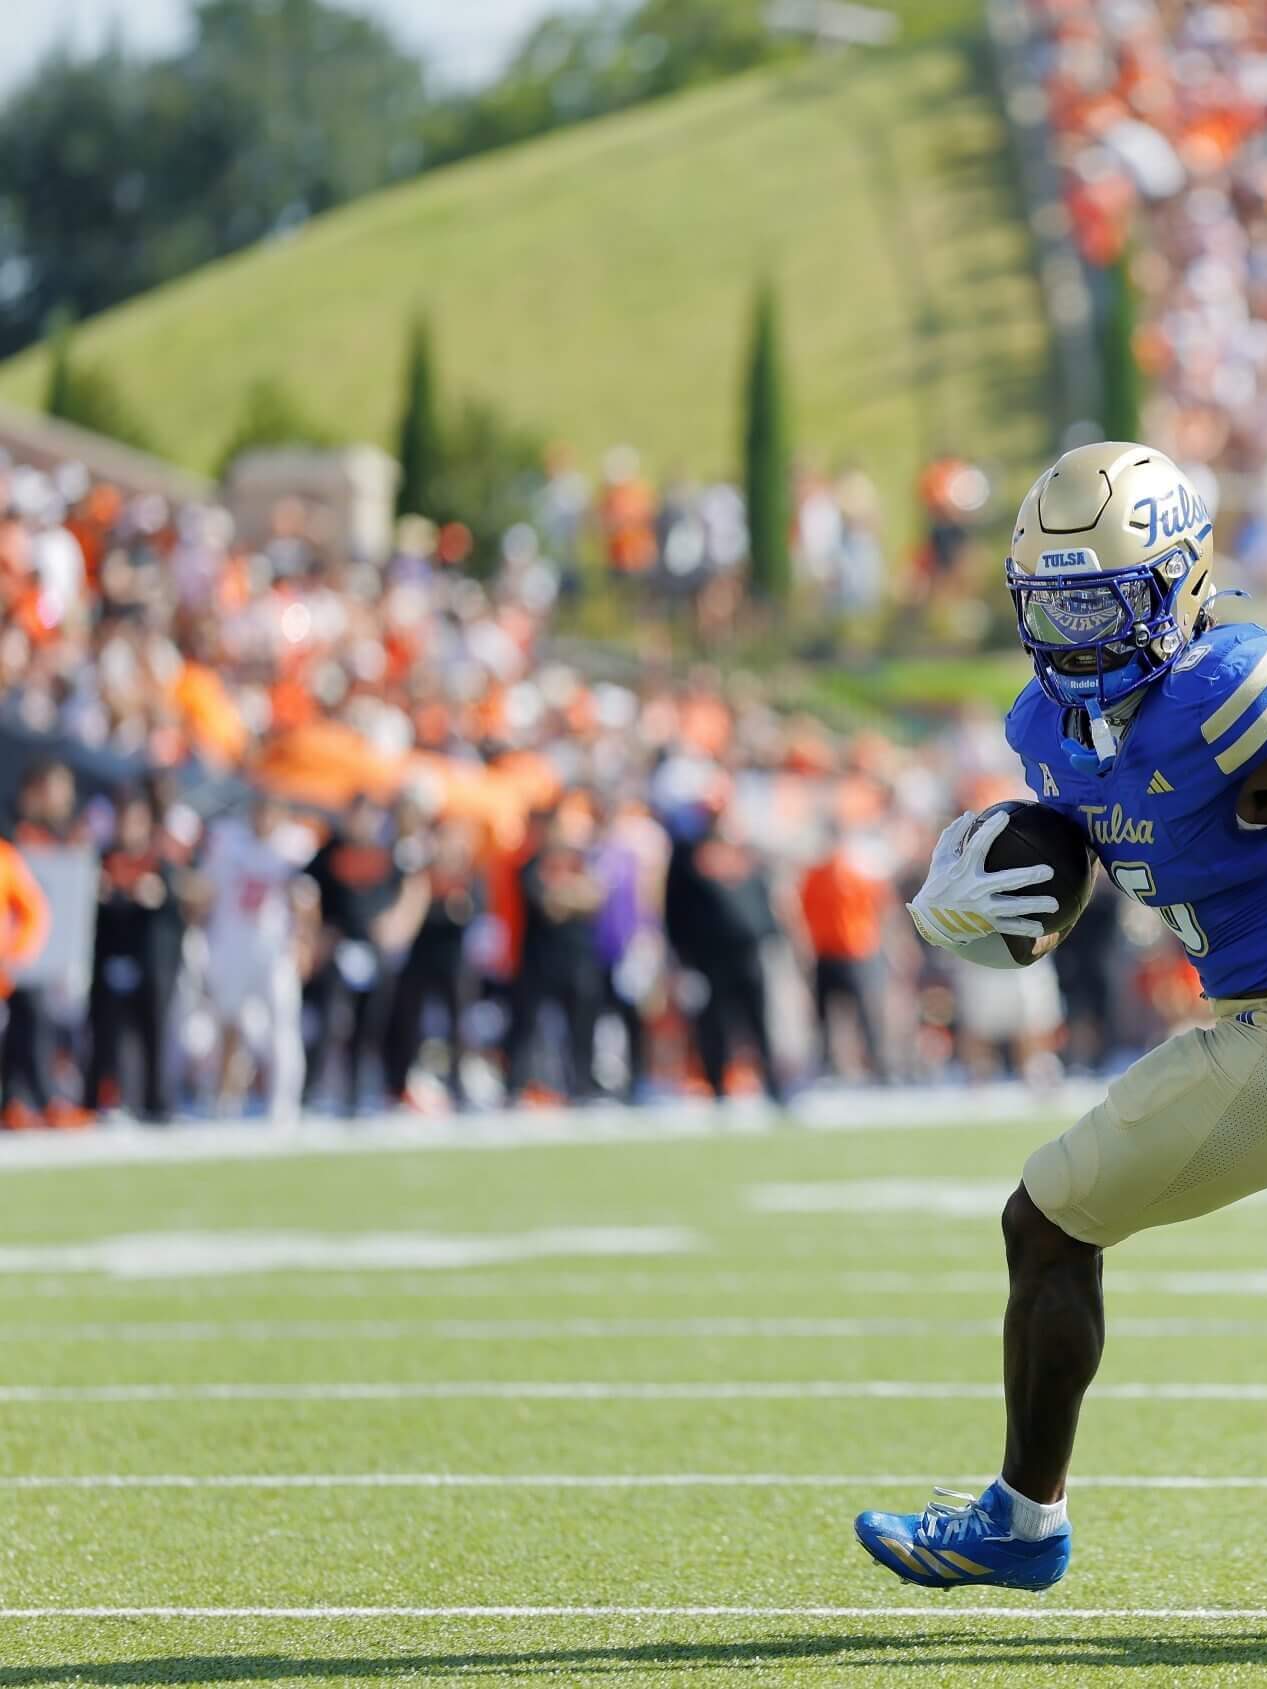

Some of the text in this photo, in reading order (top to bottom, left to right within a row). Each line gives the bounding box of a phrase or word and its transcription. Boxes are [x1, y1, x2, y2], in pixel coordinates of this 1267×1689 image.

[1043, 551, 1085, 568] TULSA
[1070, 679, 1099, 689] Riddel
[1079, 803, 1155, 844] Tulsa
